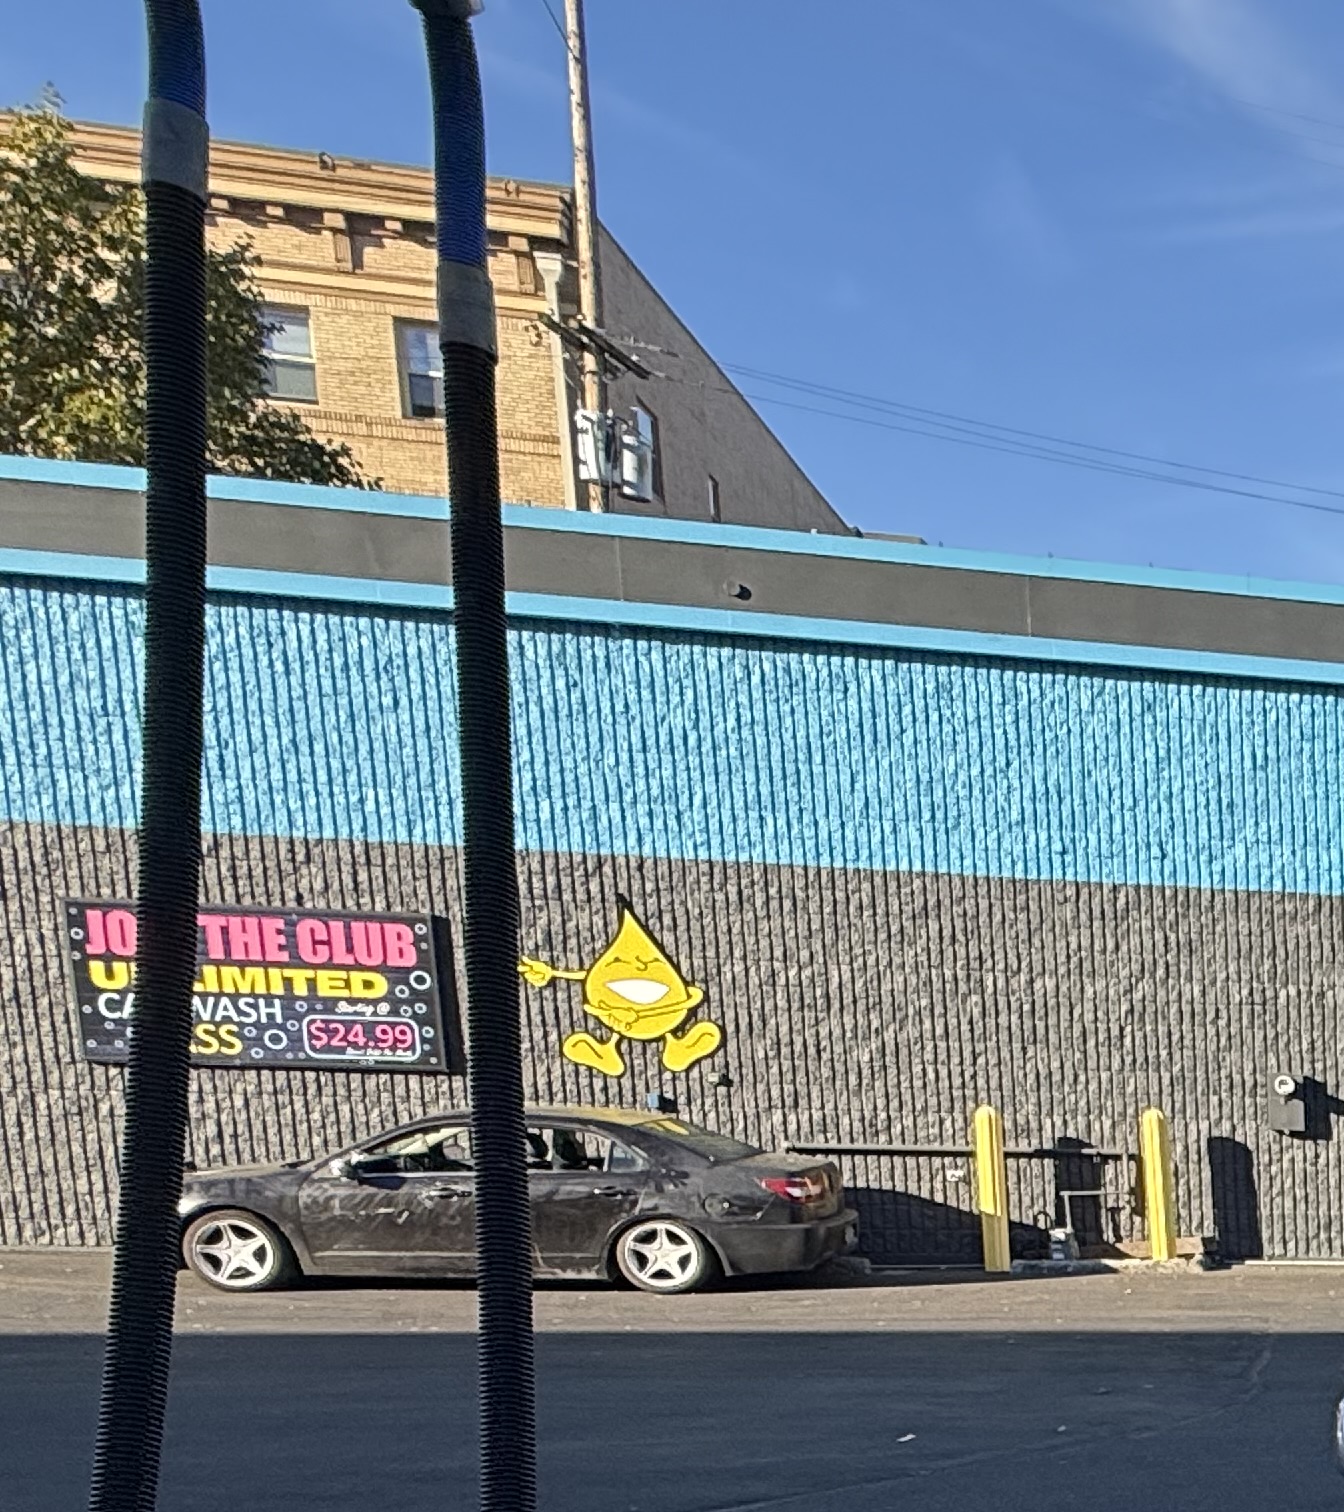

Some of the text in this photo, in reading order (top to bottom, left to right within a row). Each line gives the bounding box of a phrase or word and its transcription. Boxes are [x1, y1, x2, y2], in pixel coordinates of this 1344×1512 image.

[197, 914, 289, 962] THE
[296, 917, 417, 968] CLUB
[88, 960, 388, 999] UIMITED
[309, 1020, 413, 1049] $24.99
